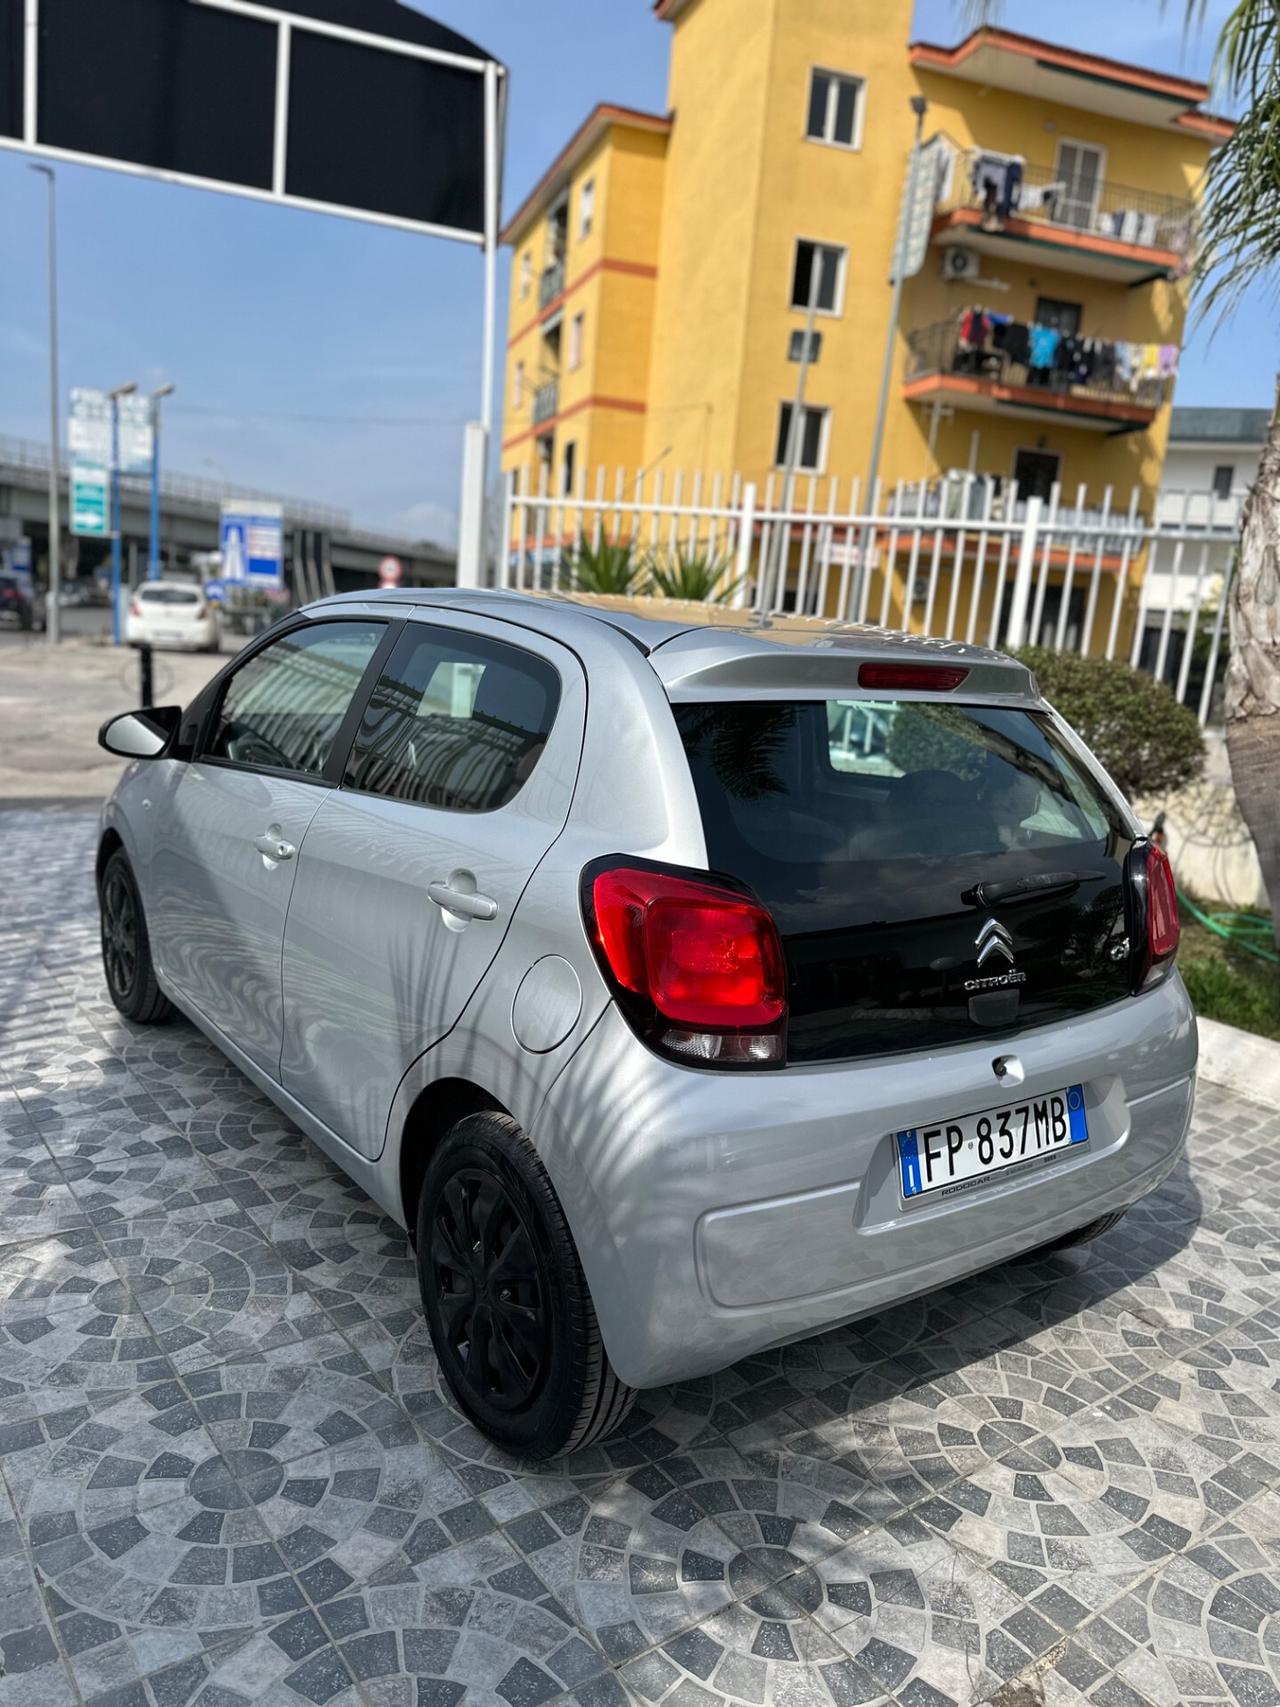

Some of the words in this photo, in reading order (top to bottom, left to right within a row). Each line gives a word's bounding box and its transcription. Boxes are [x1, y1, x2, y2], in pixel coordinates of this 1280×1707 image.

[964, 968, 1027, 991] CITROËN
[923, 1124, 963, 1183] FP
[976, 1096, 1067, 1165] 837MB
